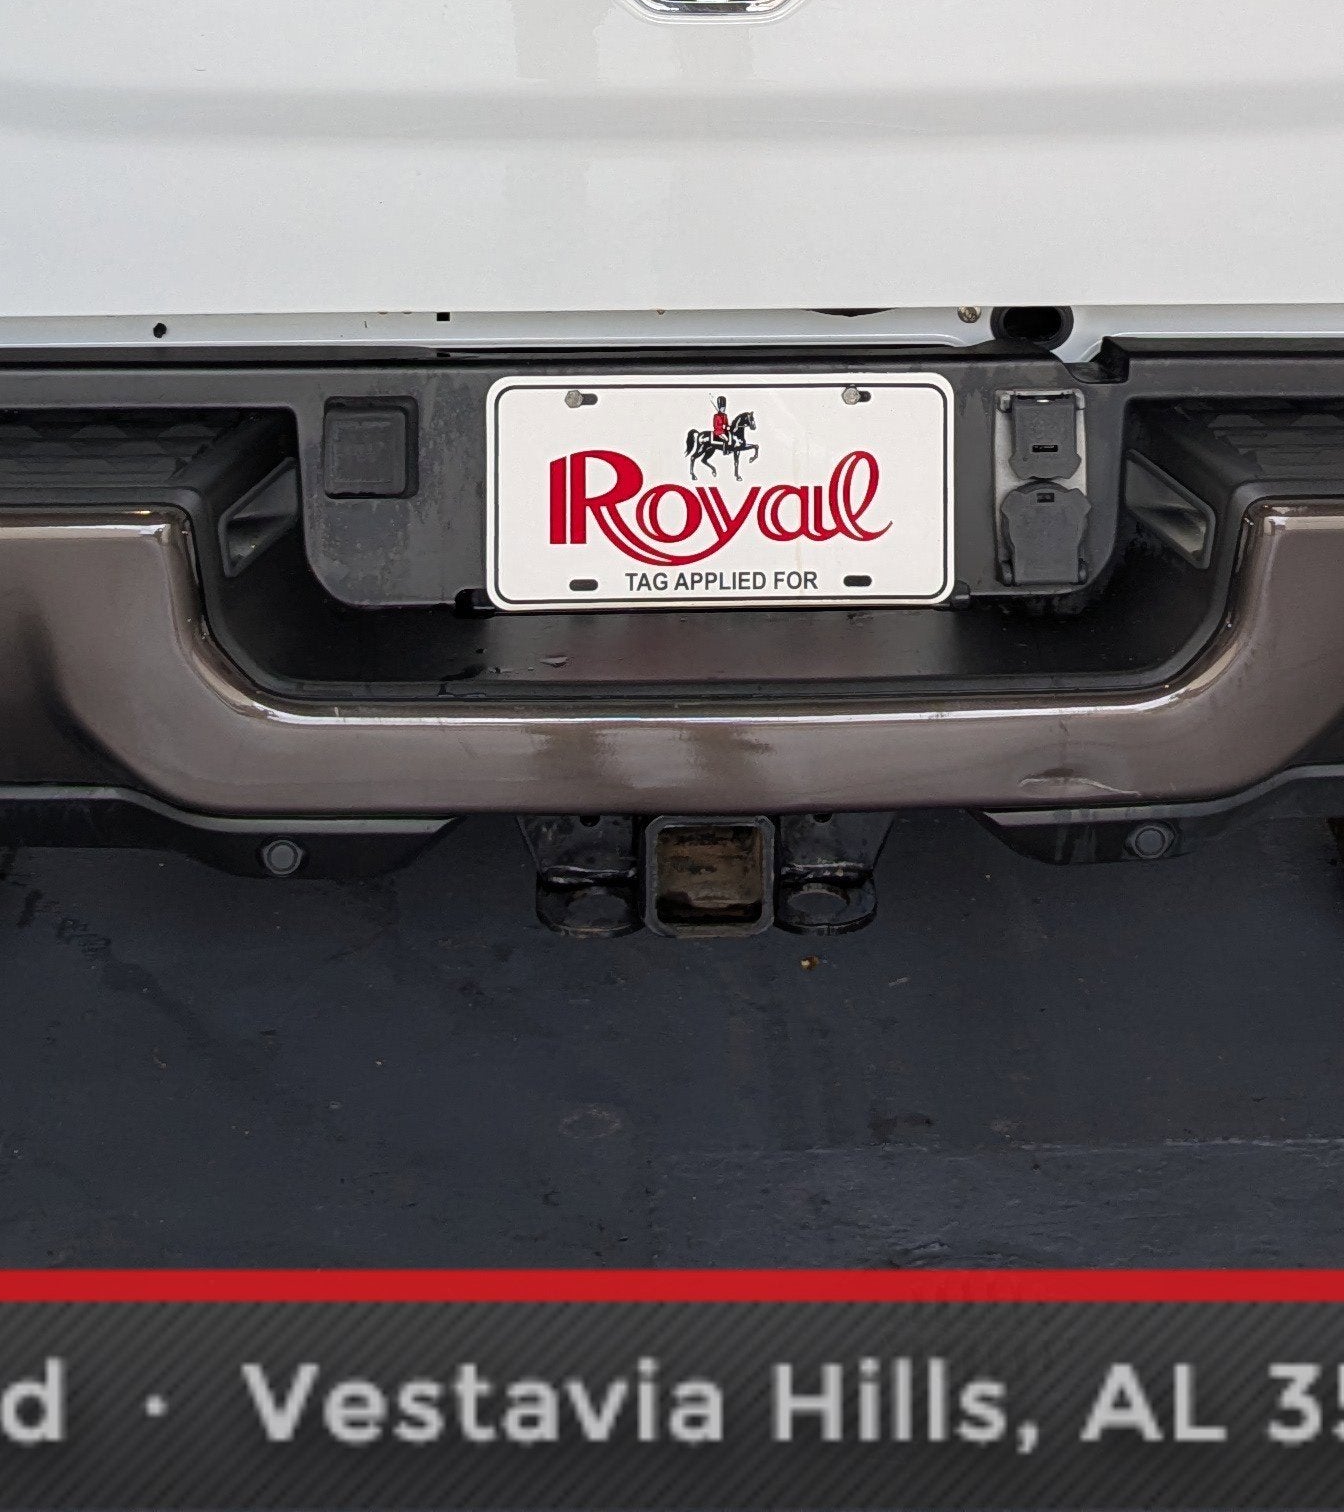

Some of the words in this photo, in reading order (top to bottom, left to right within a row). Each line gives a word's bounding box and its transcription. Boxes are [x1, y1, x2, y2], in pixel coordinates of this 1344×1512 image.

[549, 449, 893, 567] Royal
[624, 572, 669, 591] TAG
[673, 572, 767, 591] APPLIED
[773, 570, 819, 590] FOR
